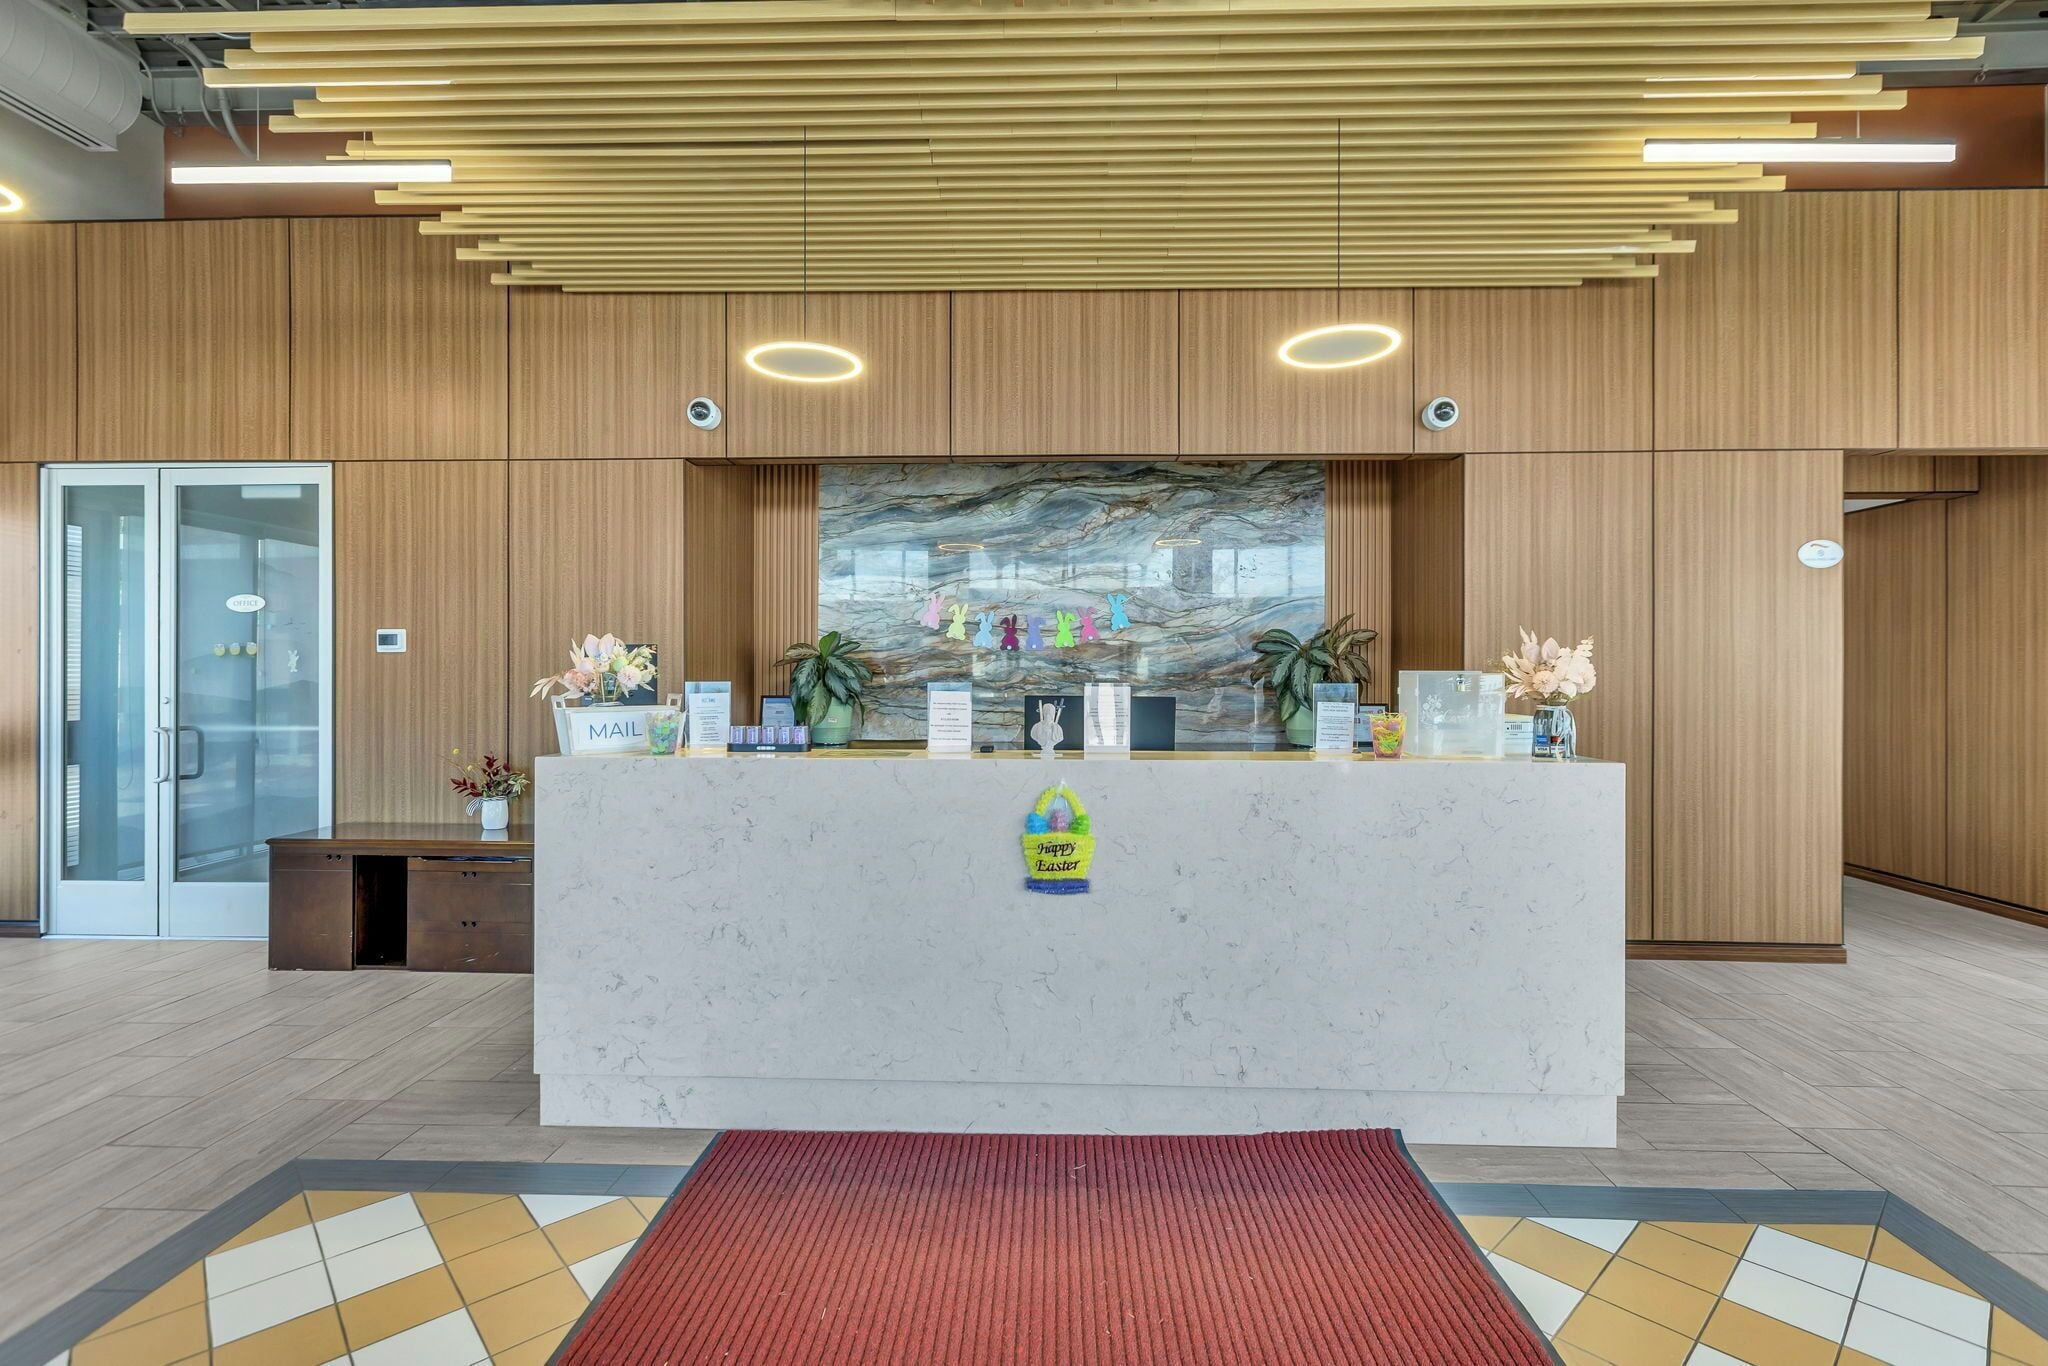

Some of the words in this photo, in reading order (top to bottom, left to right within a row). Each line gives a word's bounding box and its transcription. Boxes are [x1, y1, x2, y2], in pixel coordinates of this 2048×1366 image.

[589, 721, 643, 740] MAIL
[1037, 841, 1077, 857] Happy
[1035, 859, 1081, 872] Easter
